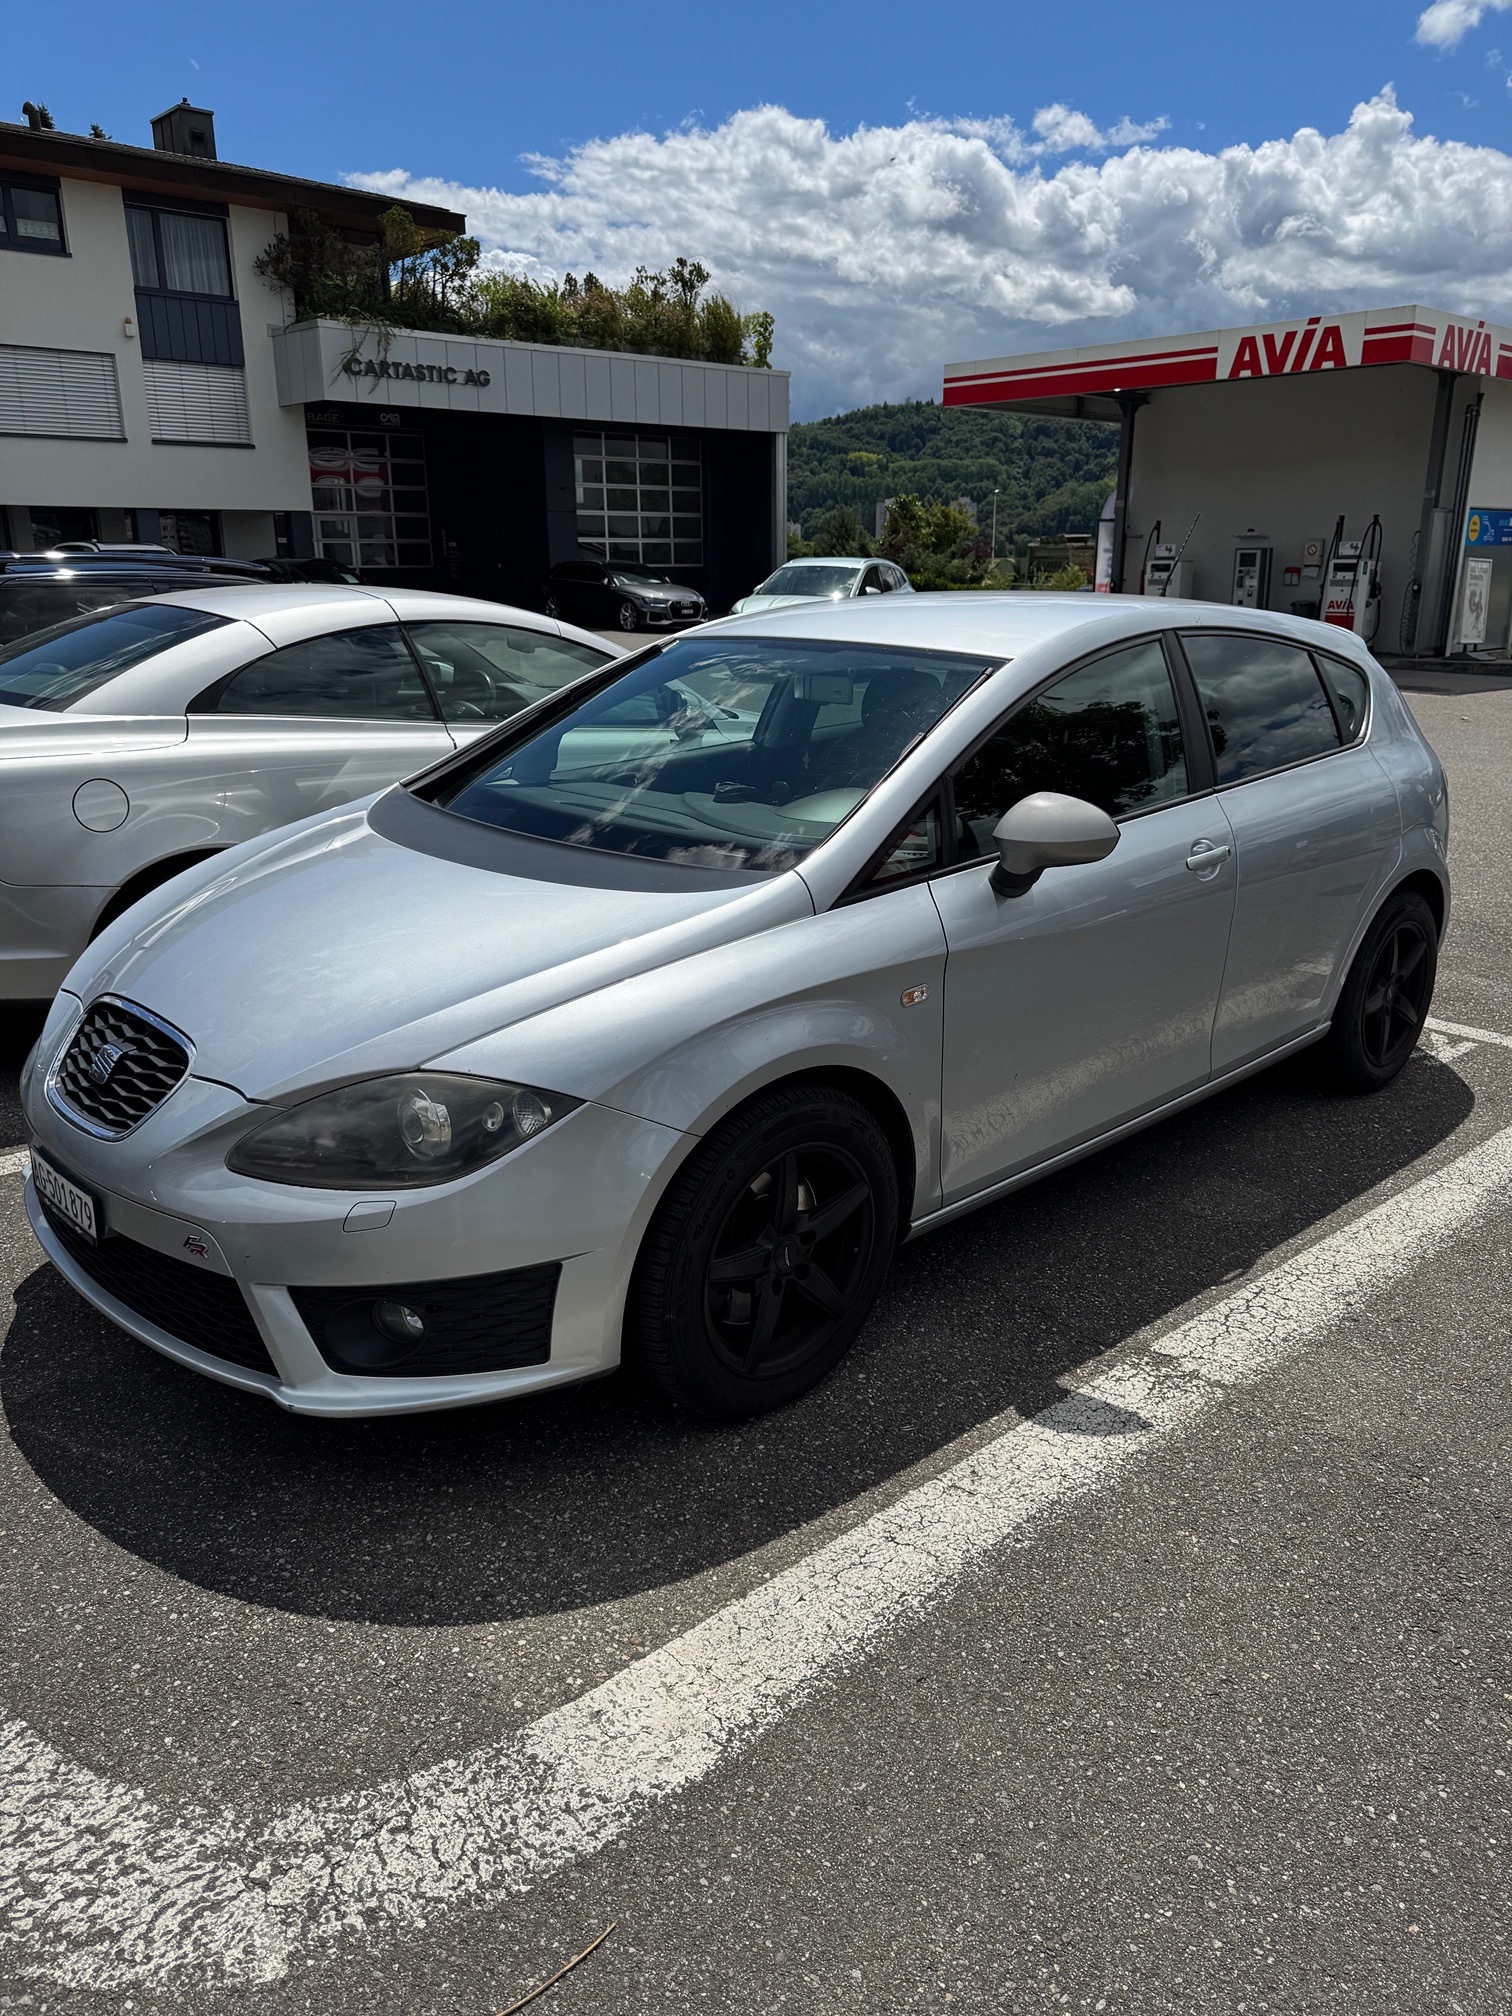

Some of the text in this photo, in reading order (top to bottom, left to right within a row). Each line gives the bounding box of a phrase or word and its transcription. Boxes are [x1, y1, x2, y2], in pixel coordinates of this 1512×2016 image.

[348, 357, 491, 387] CARTASTIC AG
[1228, 316, 1347, 379] AVIA
[1437, 321, 1492, 376] AVIA
